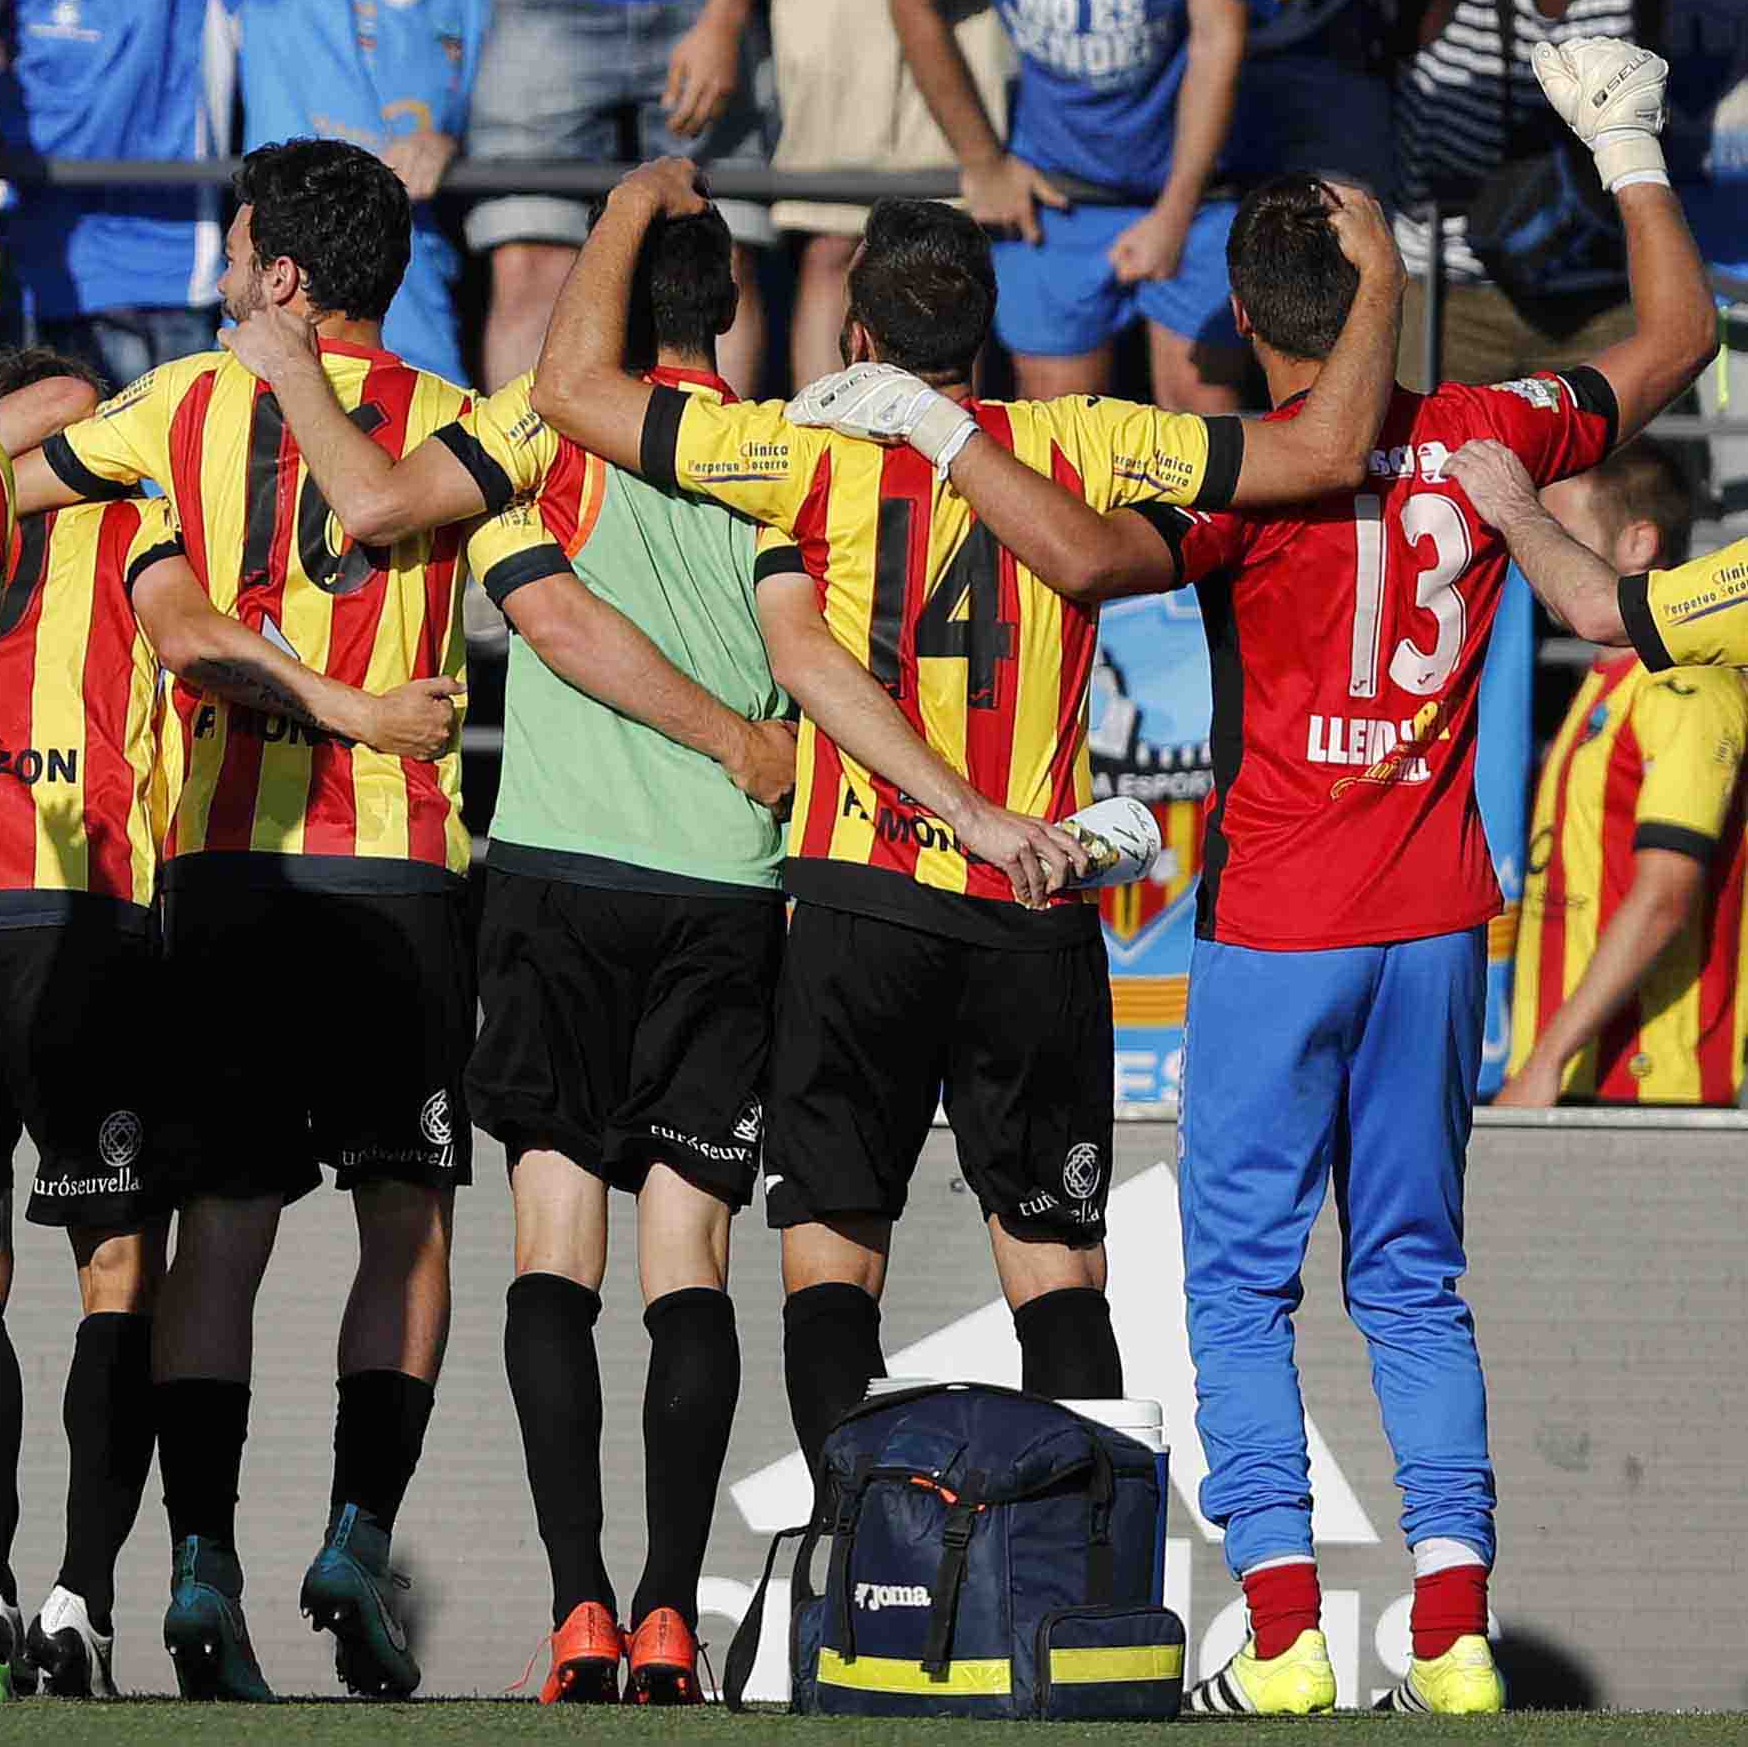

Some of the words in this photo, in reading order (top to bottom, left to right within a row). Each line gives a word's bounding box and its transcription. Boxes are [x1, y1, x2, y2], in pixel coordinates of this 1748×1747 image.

[868, 497, 1018, 710] 14
[1348, 491, 1473, 698] 13
[33, 1167, 141, 1197] uróseuvella
